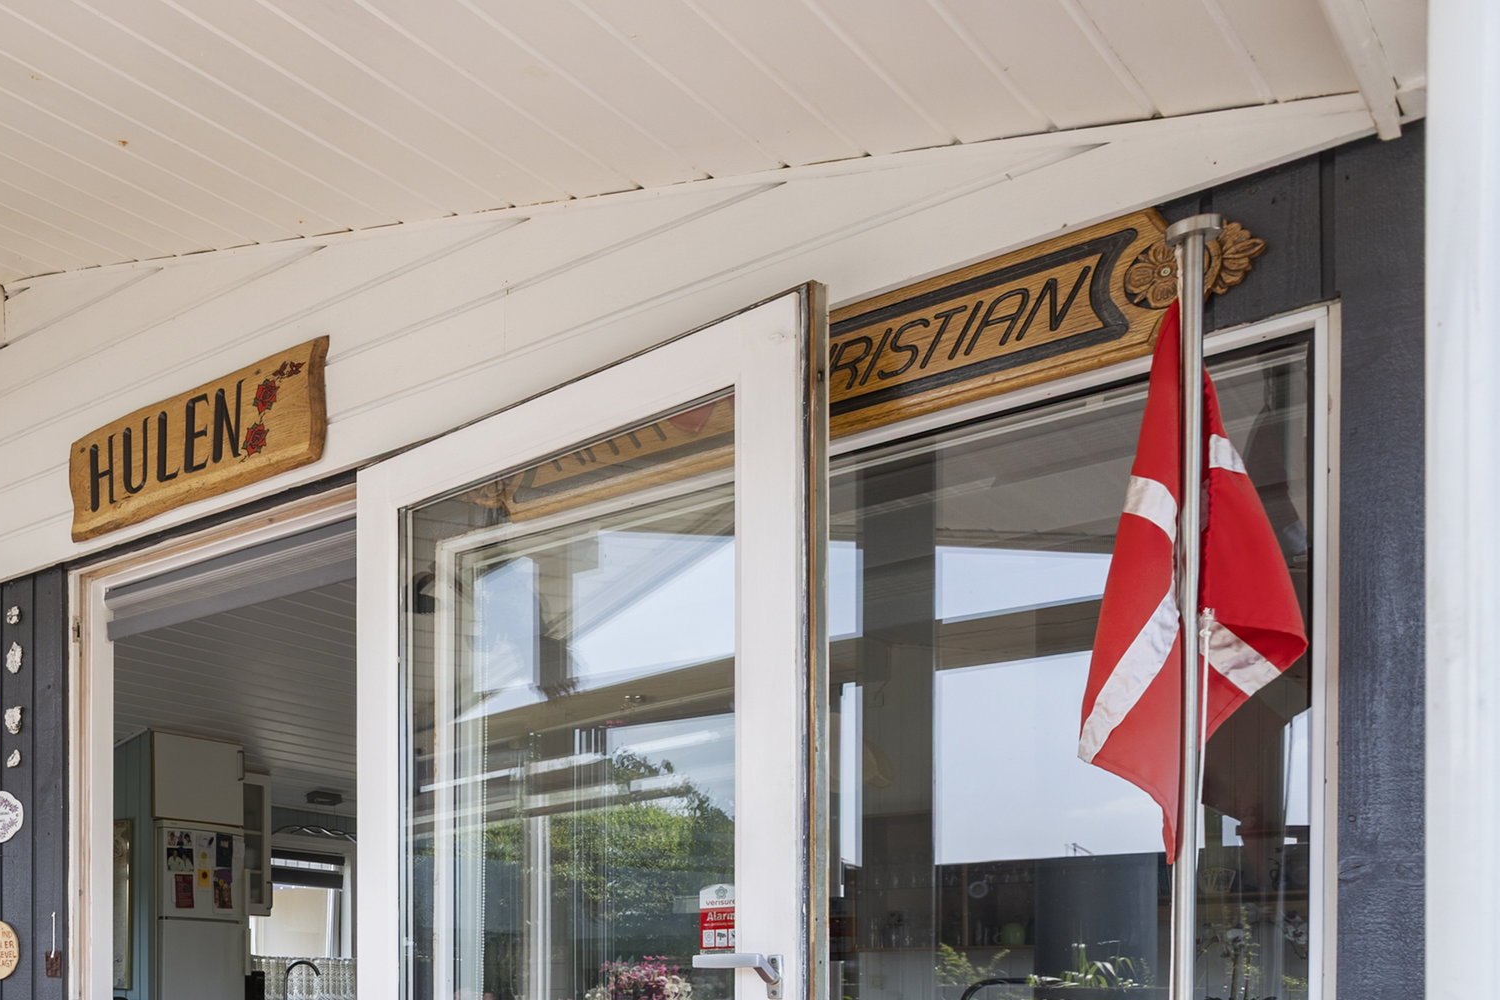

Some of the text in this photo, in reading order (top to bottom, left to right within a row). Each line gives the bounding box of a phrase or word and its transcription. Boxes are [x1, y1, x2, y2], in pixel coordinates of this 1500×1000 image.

[829, 265, 1092, 390] RISTIAN
[89, 378, 247, 513] HULEN
[2, 930, 12, 938] IND
[4, 940, 14, 949] ER
